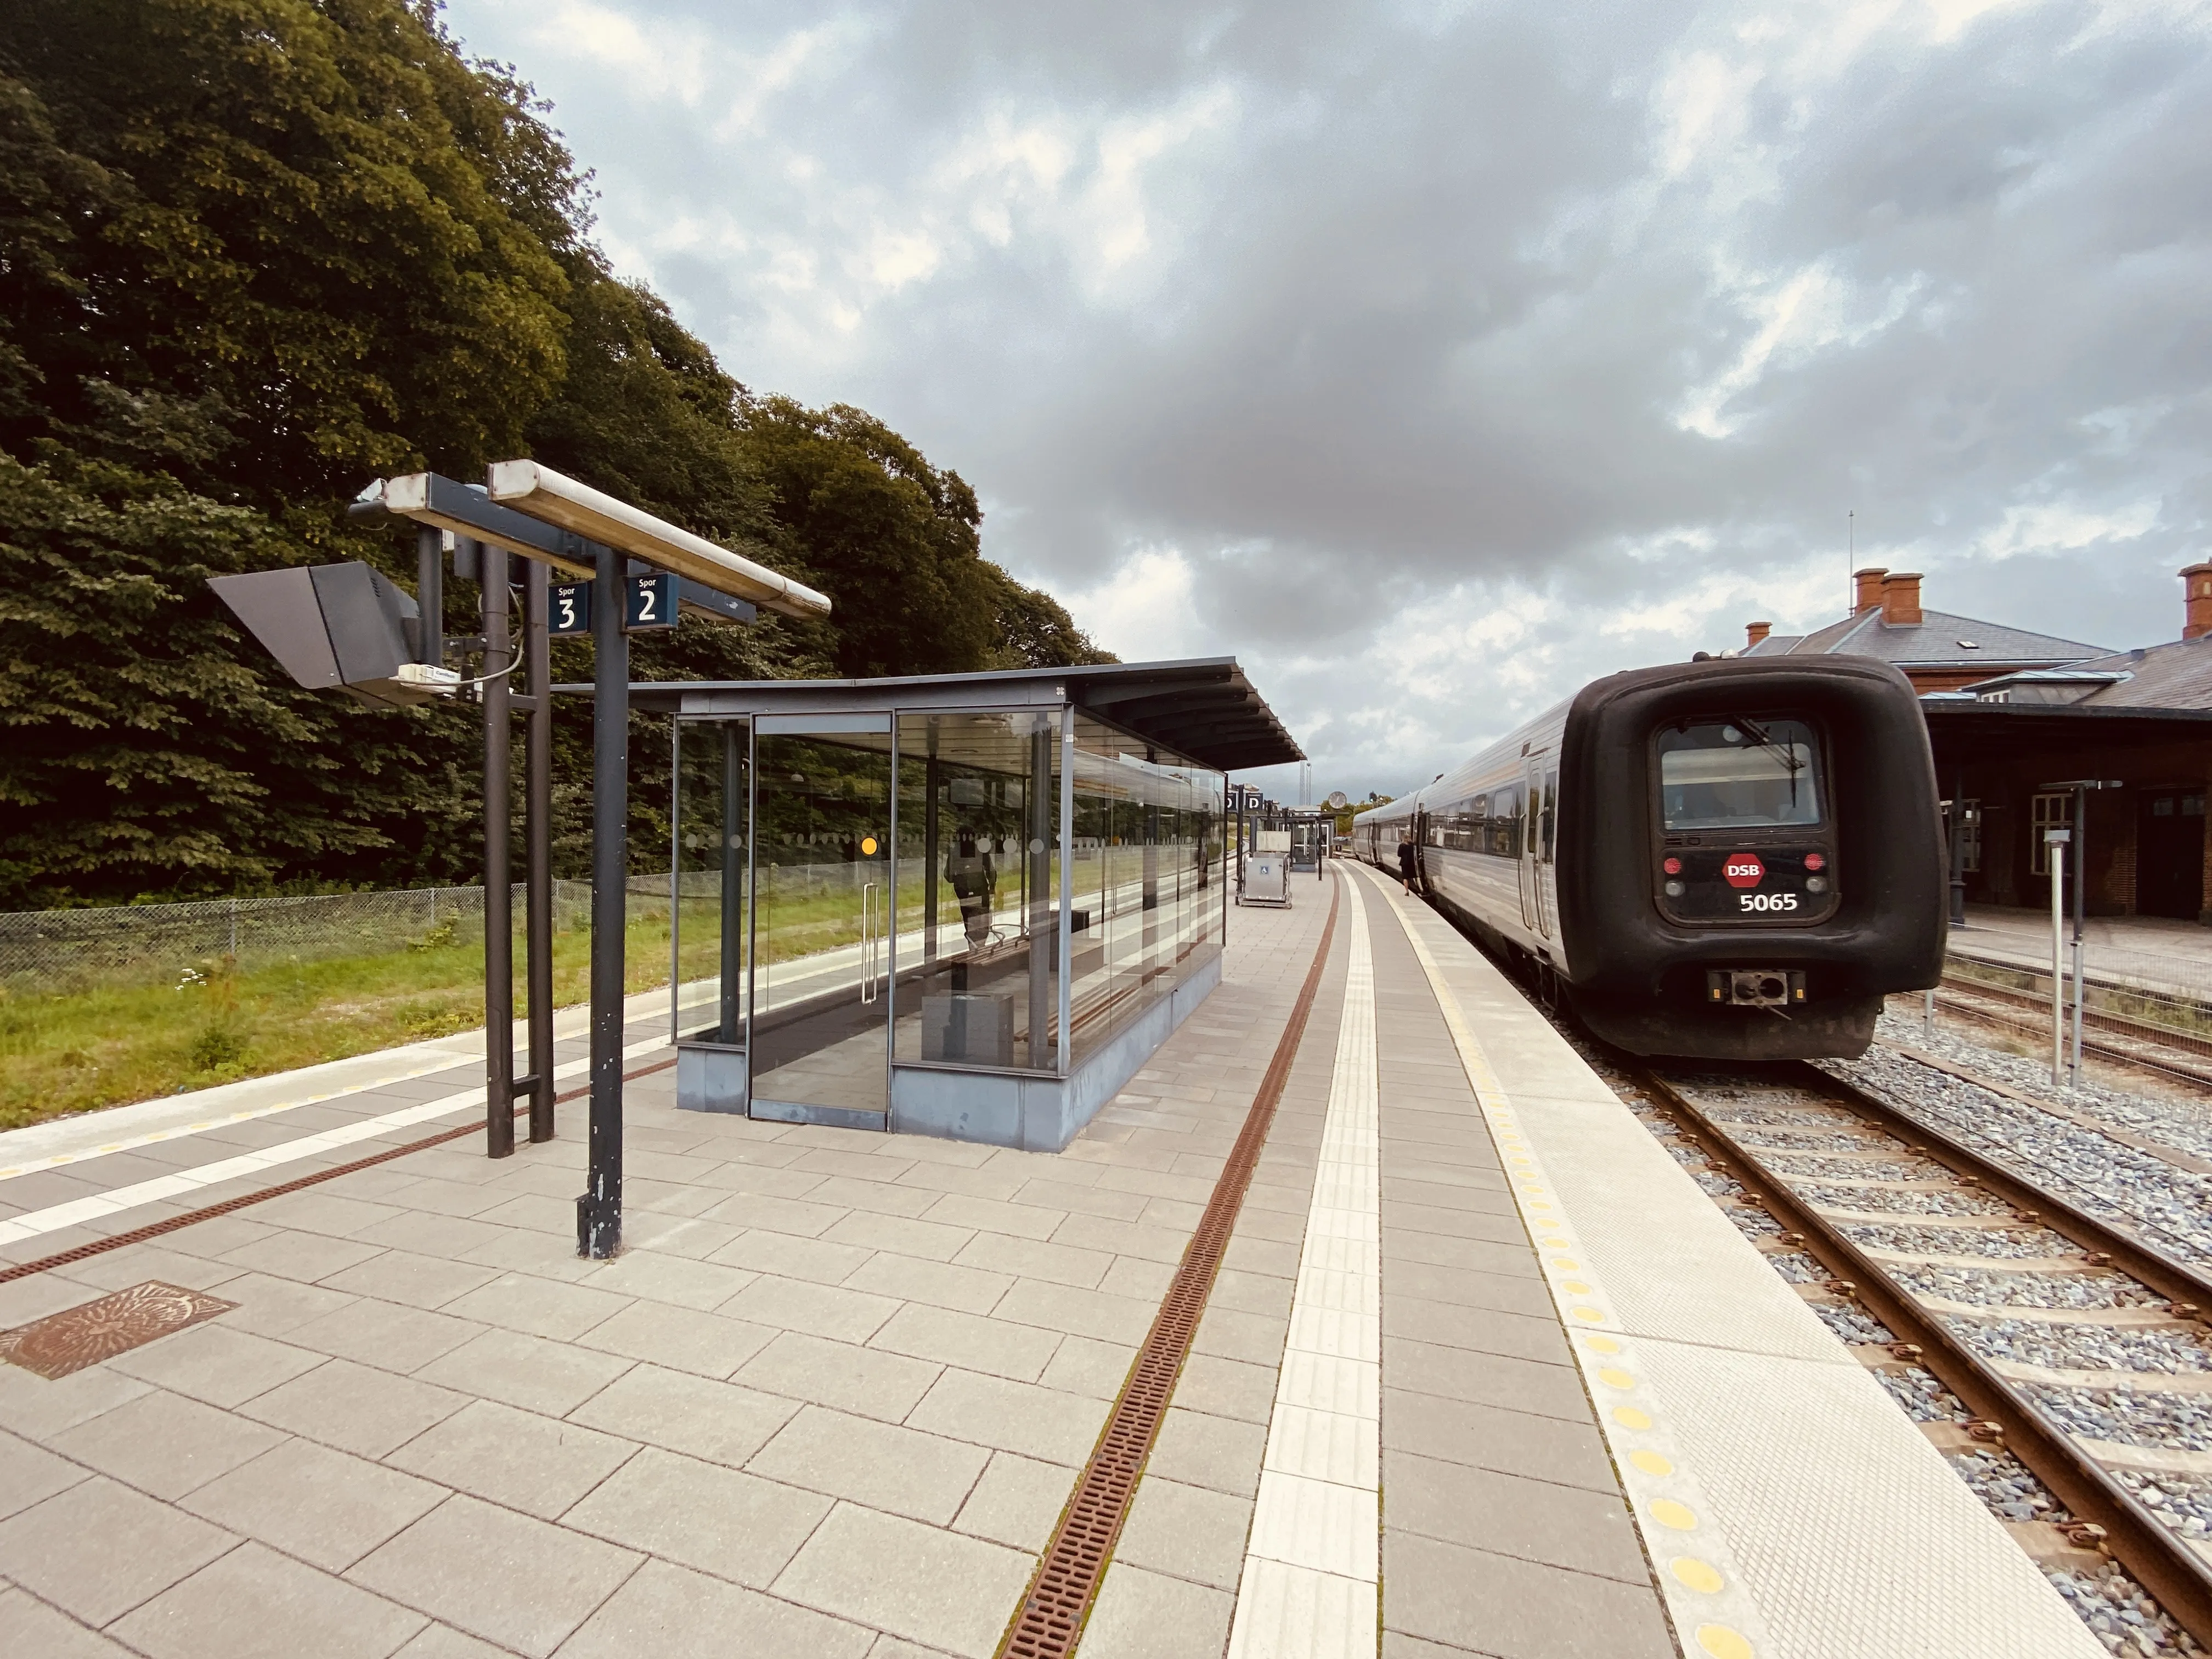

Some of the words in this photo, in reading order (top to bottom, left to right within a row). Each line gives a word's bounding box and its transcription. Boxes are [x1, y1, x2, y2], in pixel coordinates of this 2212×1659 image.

[639, 579, 656, 589] Spor
[558, 588, 575, 597] Spor
[639, 590, 656, 621] 2
[558, 599, 575, 629] 3
[1249, 798, 1259, 809] D
[1728, 865, 1760, 877] DSB
[1740, 893, 1798, 912] 5065
